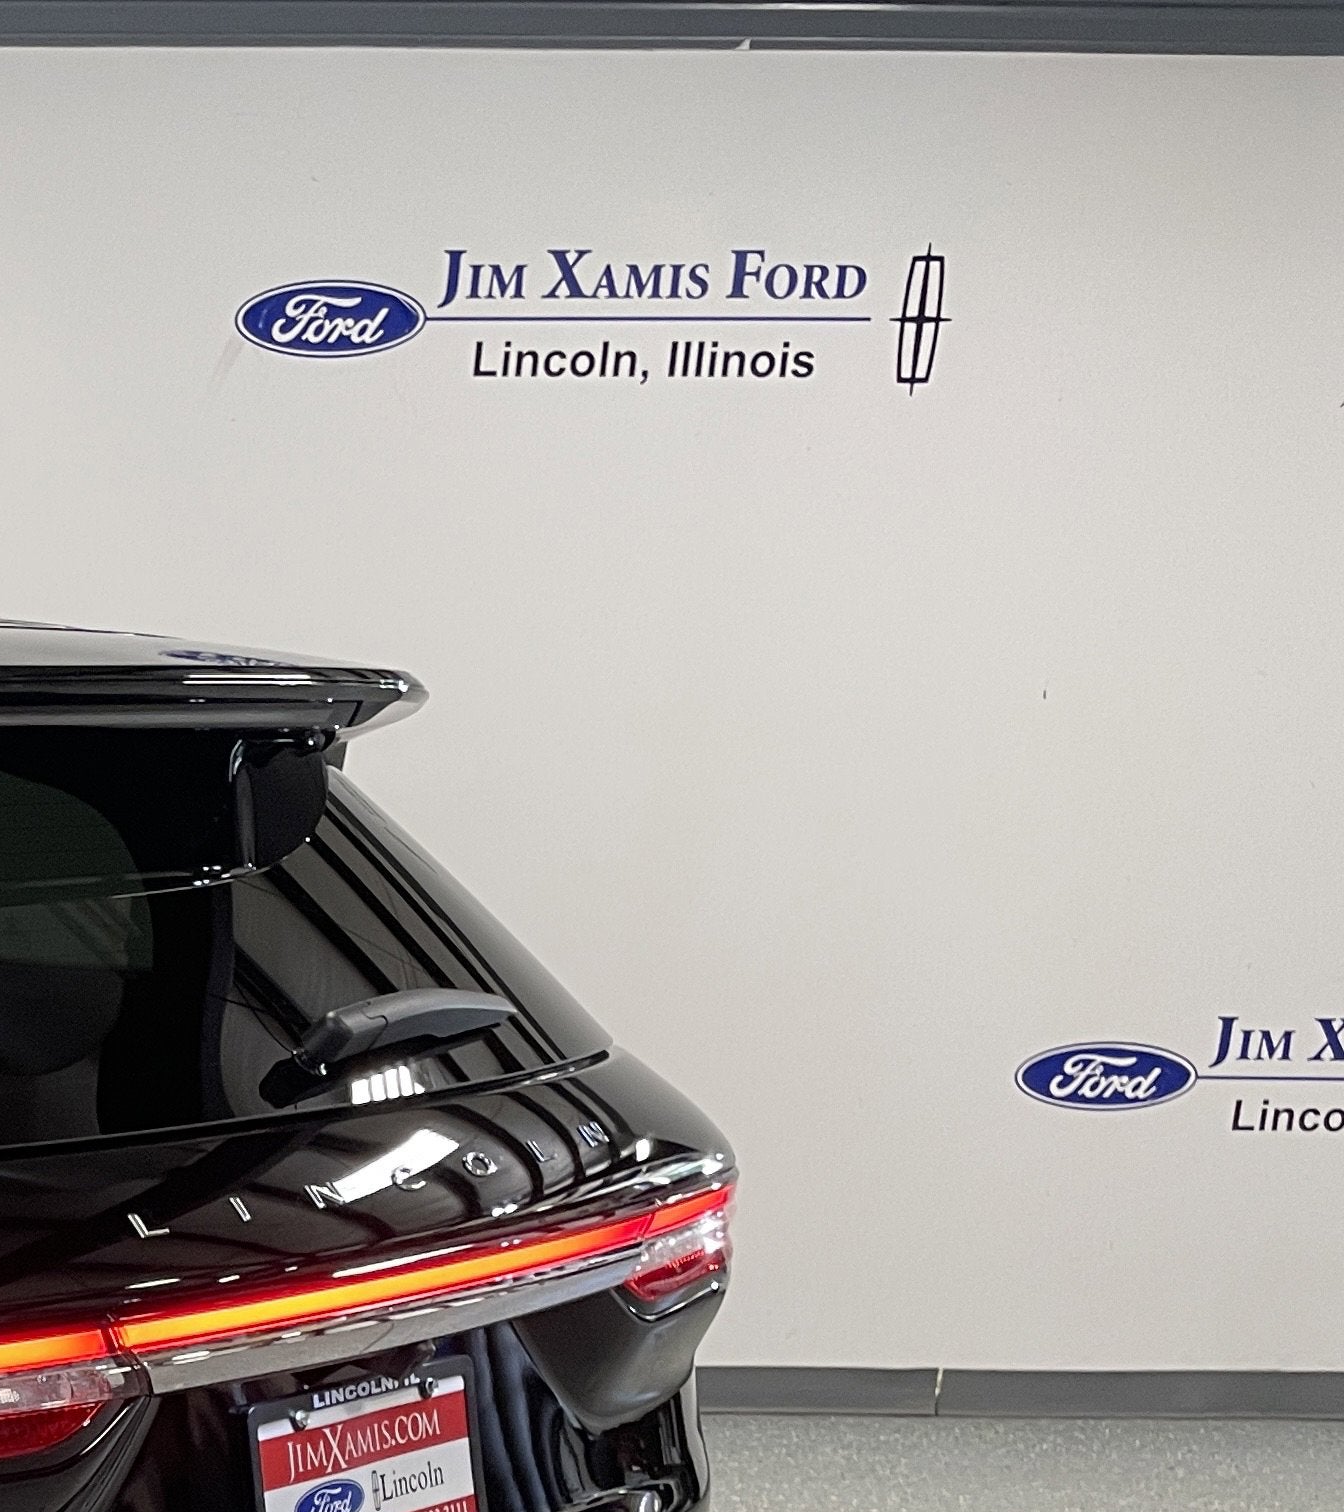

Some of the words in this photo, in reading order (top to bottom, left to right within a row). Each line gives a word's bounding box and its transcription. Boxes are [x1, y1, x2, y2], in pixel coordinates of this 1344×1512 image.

[438, 250, 527, 308] JIM
[542, 250, 709, 299] XAMIS
[726, 250, 866, 299] FORD
[270, 294, 386, 345] Ford
[474, 341, 648, 384] Lincoln,
[668, 341, 814, 377] Illinois
[1209, 1017, 1294, 1067] JIM
[1048, 1053, 1162, 1101] Ford
[127, 1120, 612, 1239] LINCOLN
[287, 1409, 441, 1484] JIMXAMIS.COM
[379, 1460, 445, 1503] Lincoln
